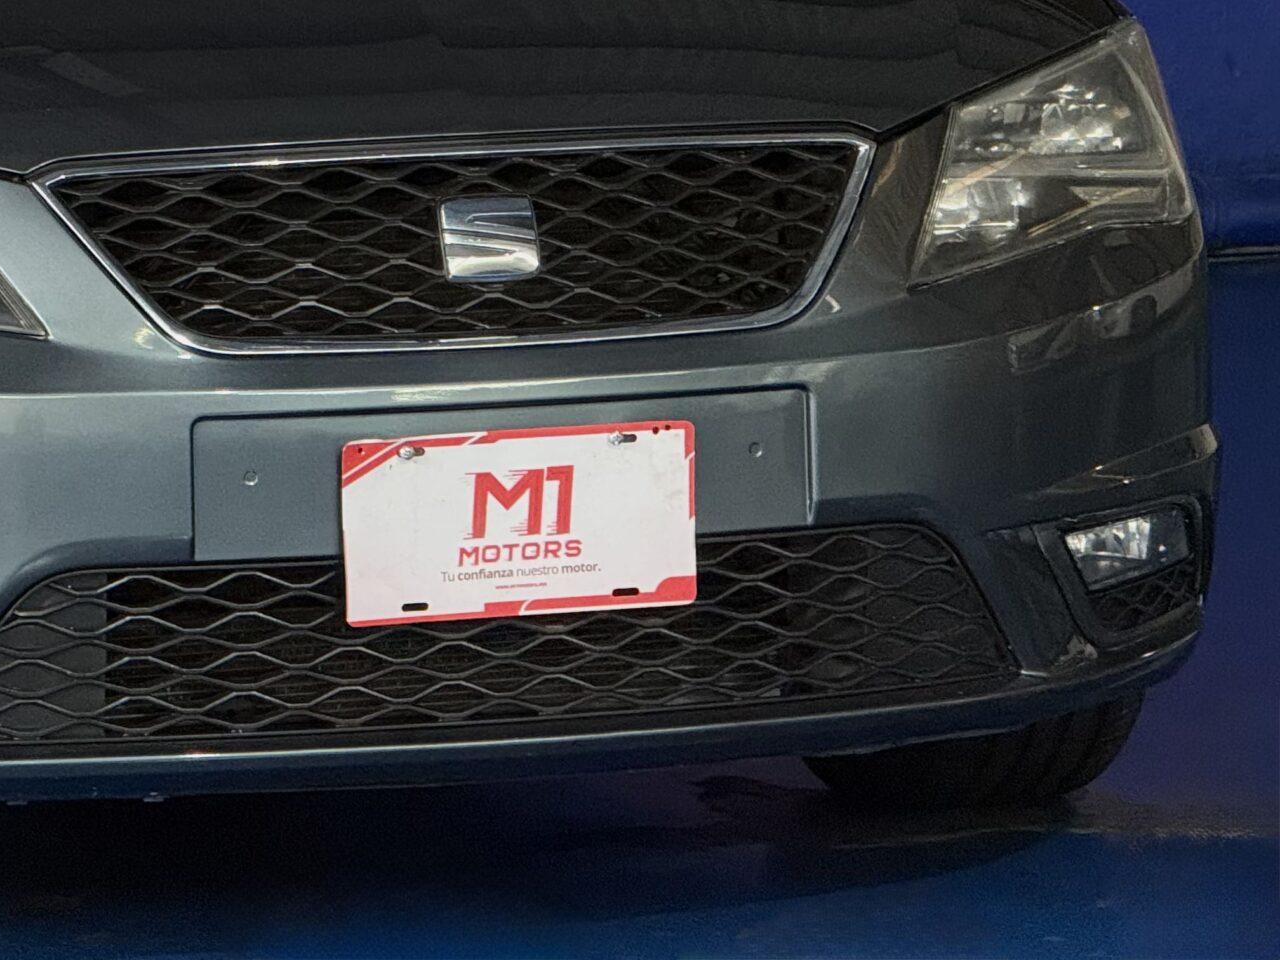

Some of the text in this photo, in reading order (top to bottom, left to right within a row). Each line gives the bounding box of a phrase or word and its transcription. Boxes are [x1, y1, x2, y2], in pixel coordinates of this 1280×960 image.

[463, 465, 574, 540] M1
[458, 540, 582, 567] MOTORS
[441, 562, 602, 583] Tu confianza nuestro motor.
